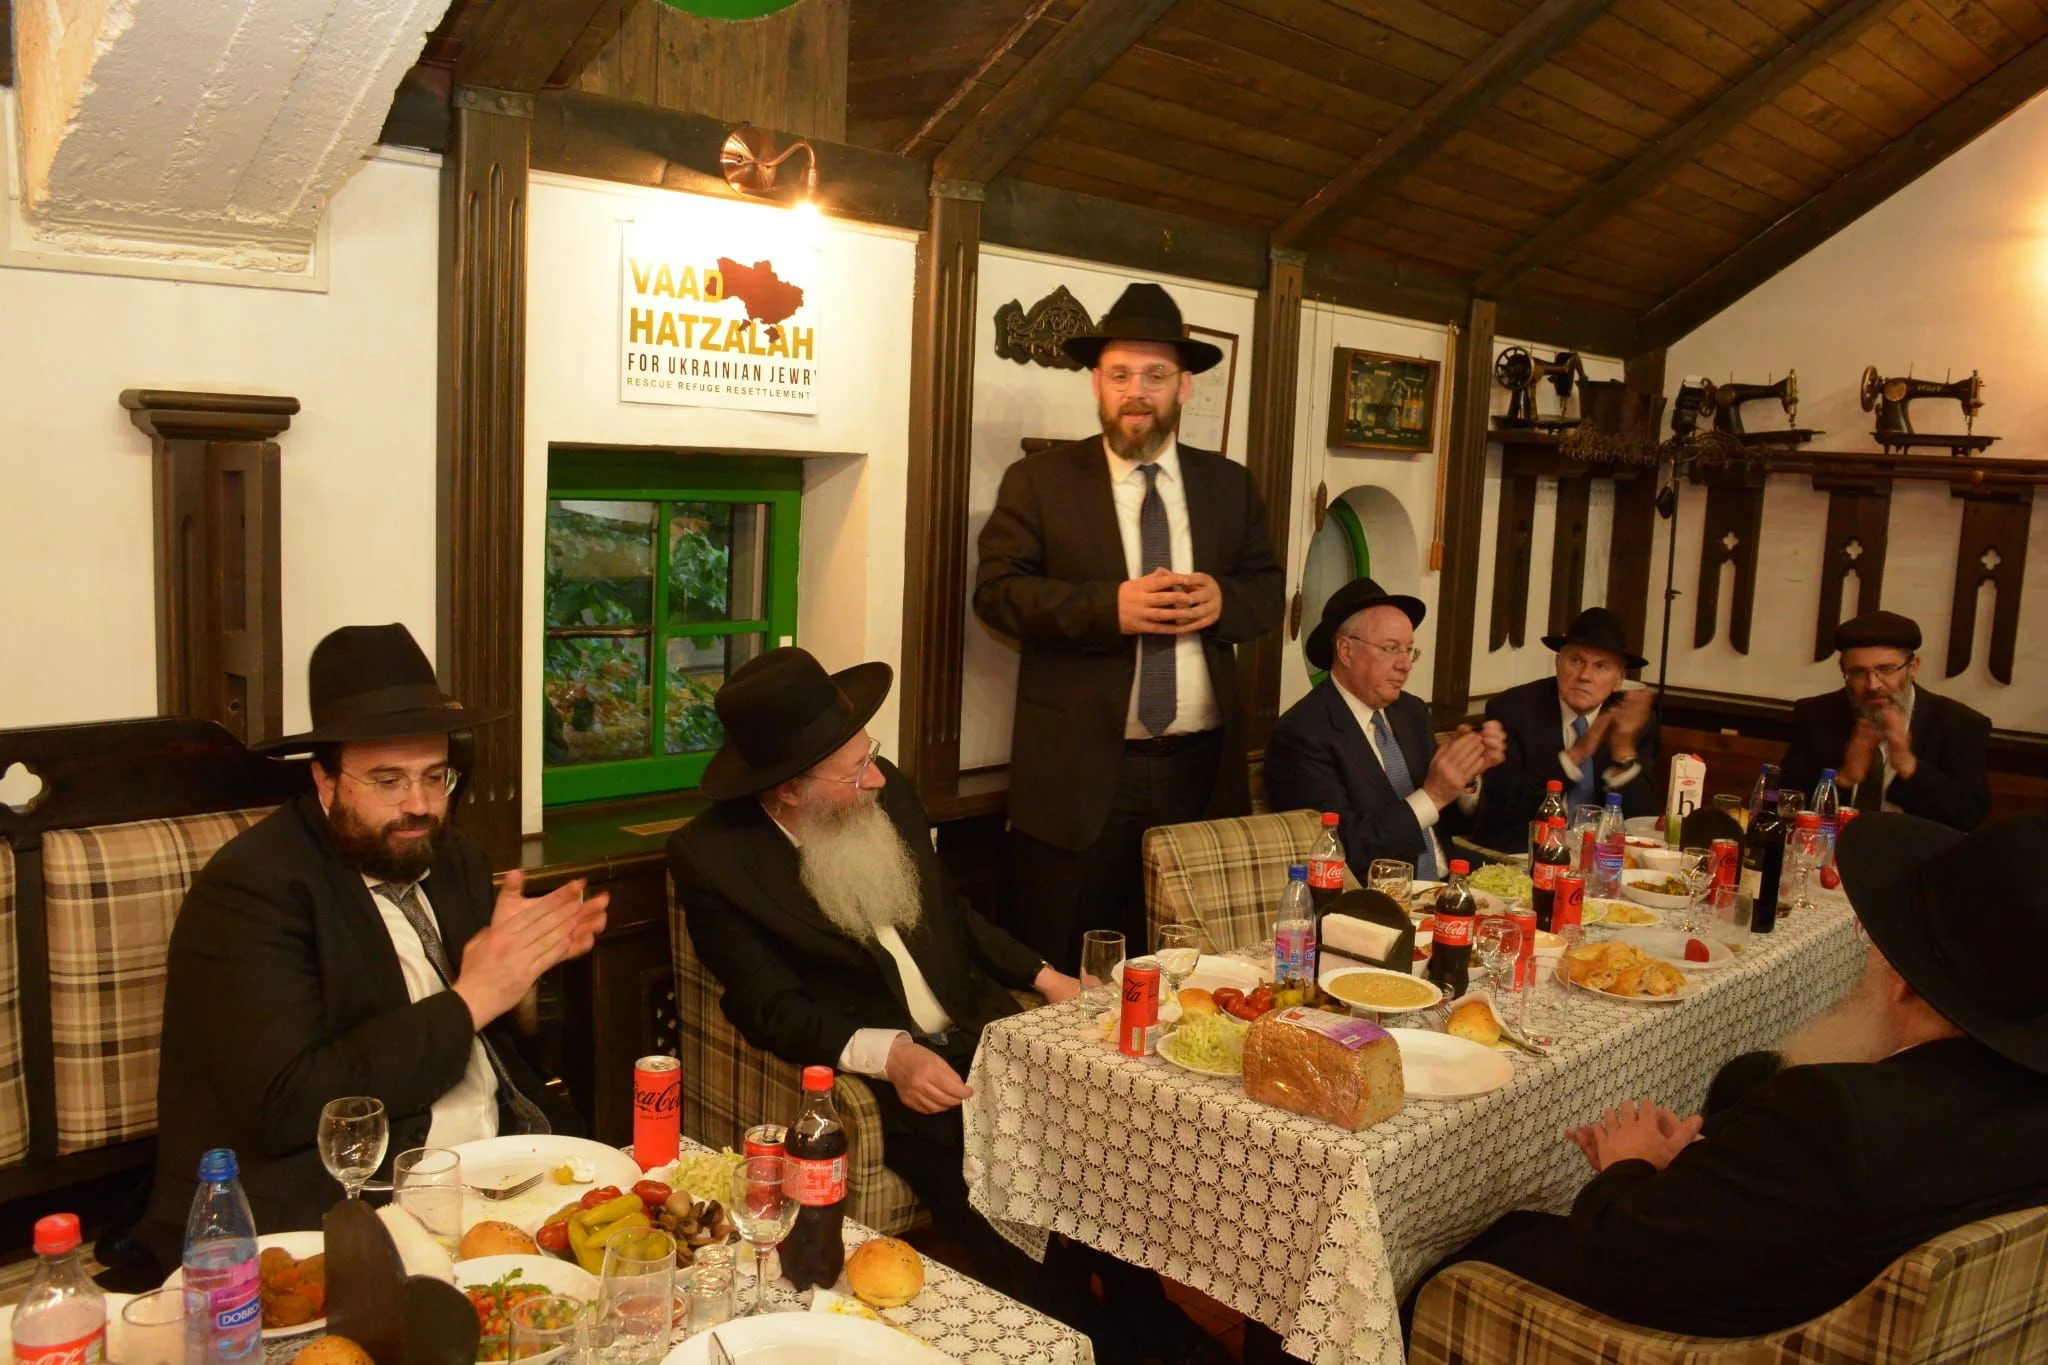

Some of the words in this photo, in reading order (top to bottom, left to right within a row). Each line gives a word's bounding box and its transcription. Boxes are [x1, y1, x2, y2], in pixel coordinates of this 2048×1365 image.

[629, 256, 724, 303] VAAD
[629, 307, 814, 361] HATZALAH
[628, 352, 660, 373] FOR
[668, 356, 762, 382] UKRAINIAN
[627, 377, 672, 389] RESCUE
[678, 381, 721, 393] REFUGE
[726, 385, 811, 399] RESETTLEMENT
